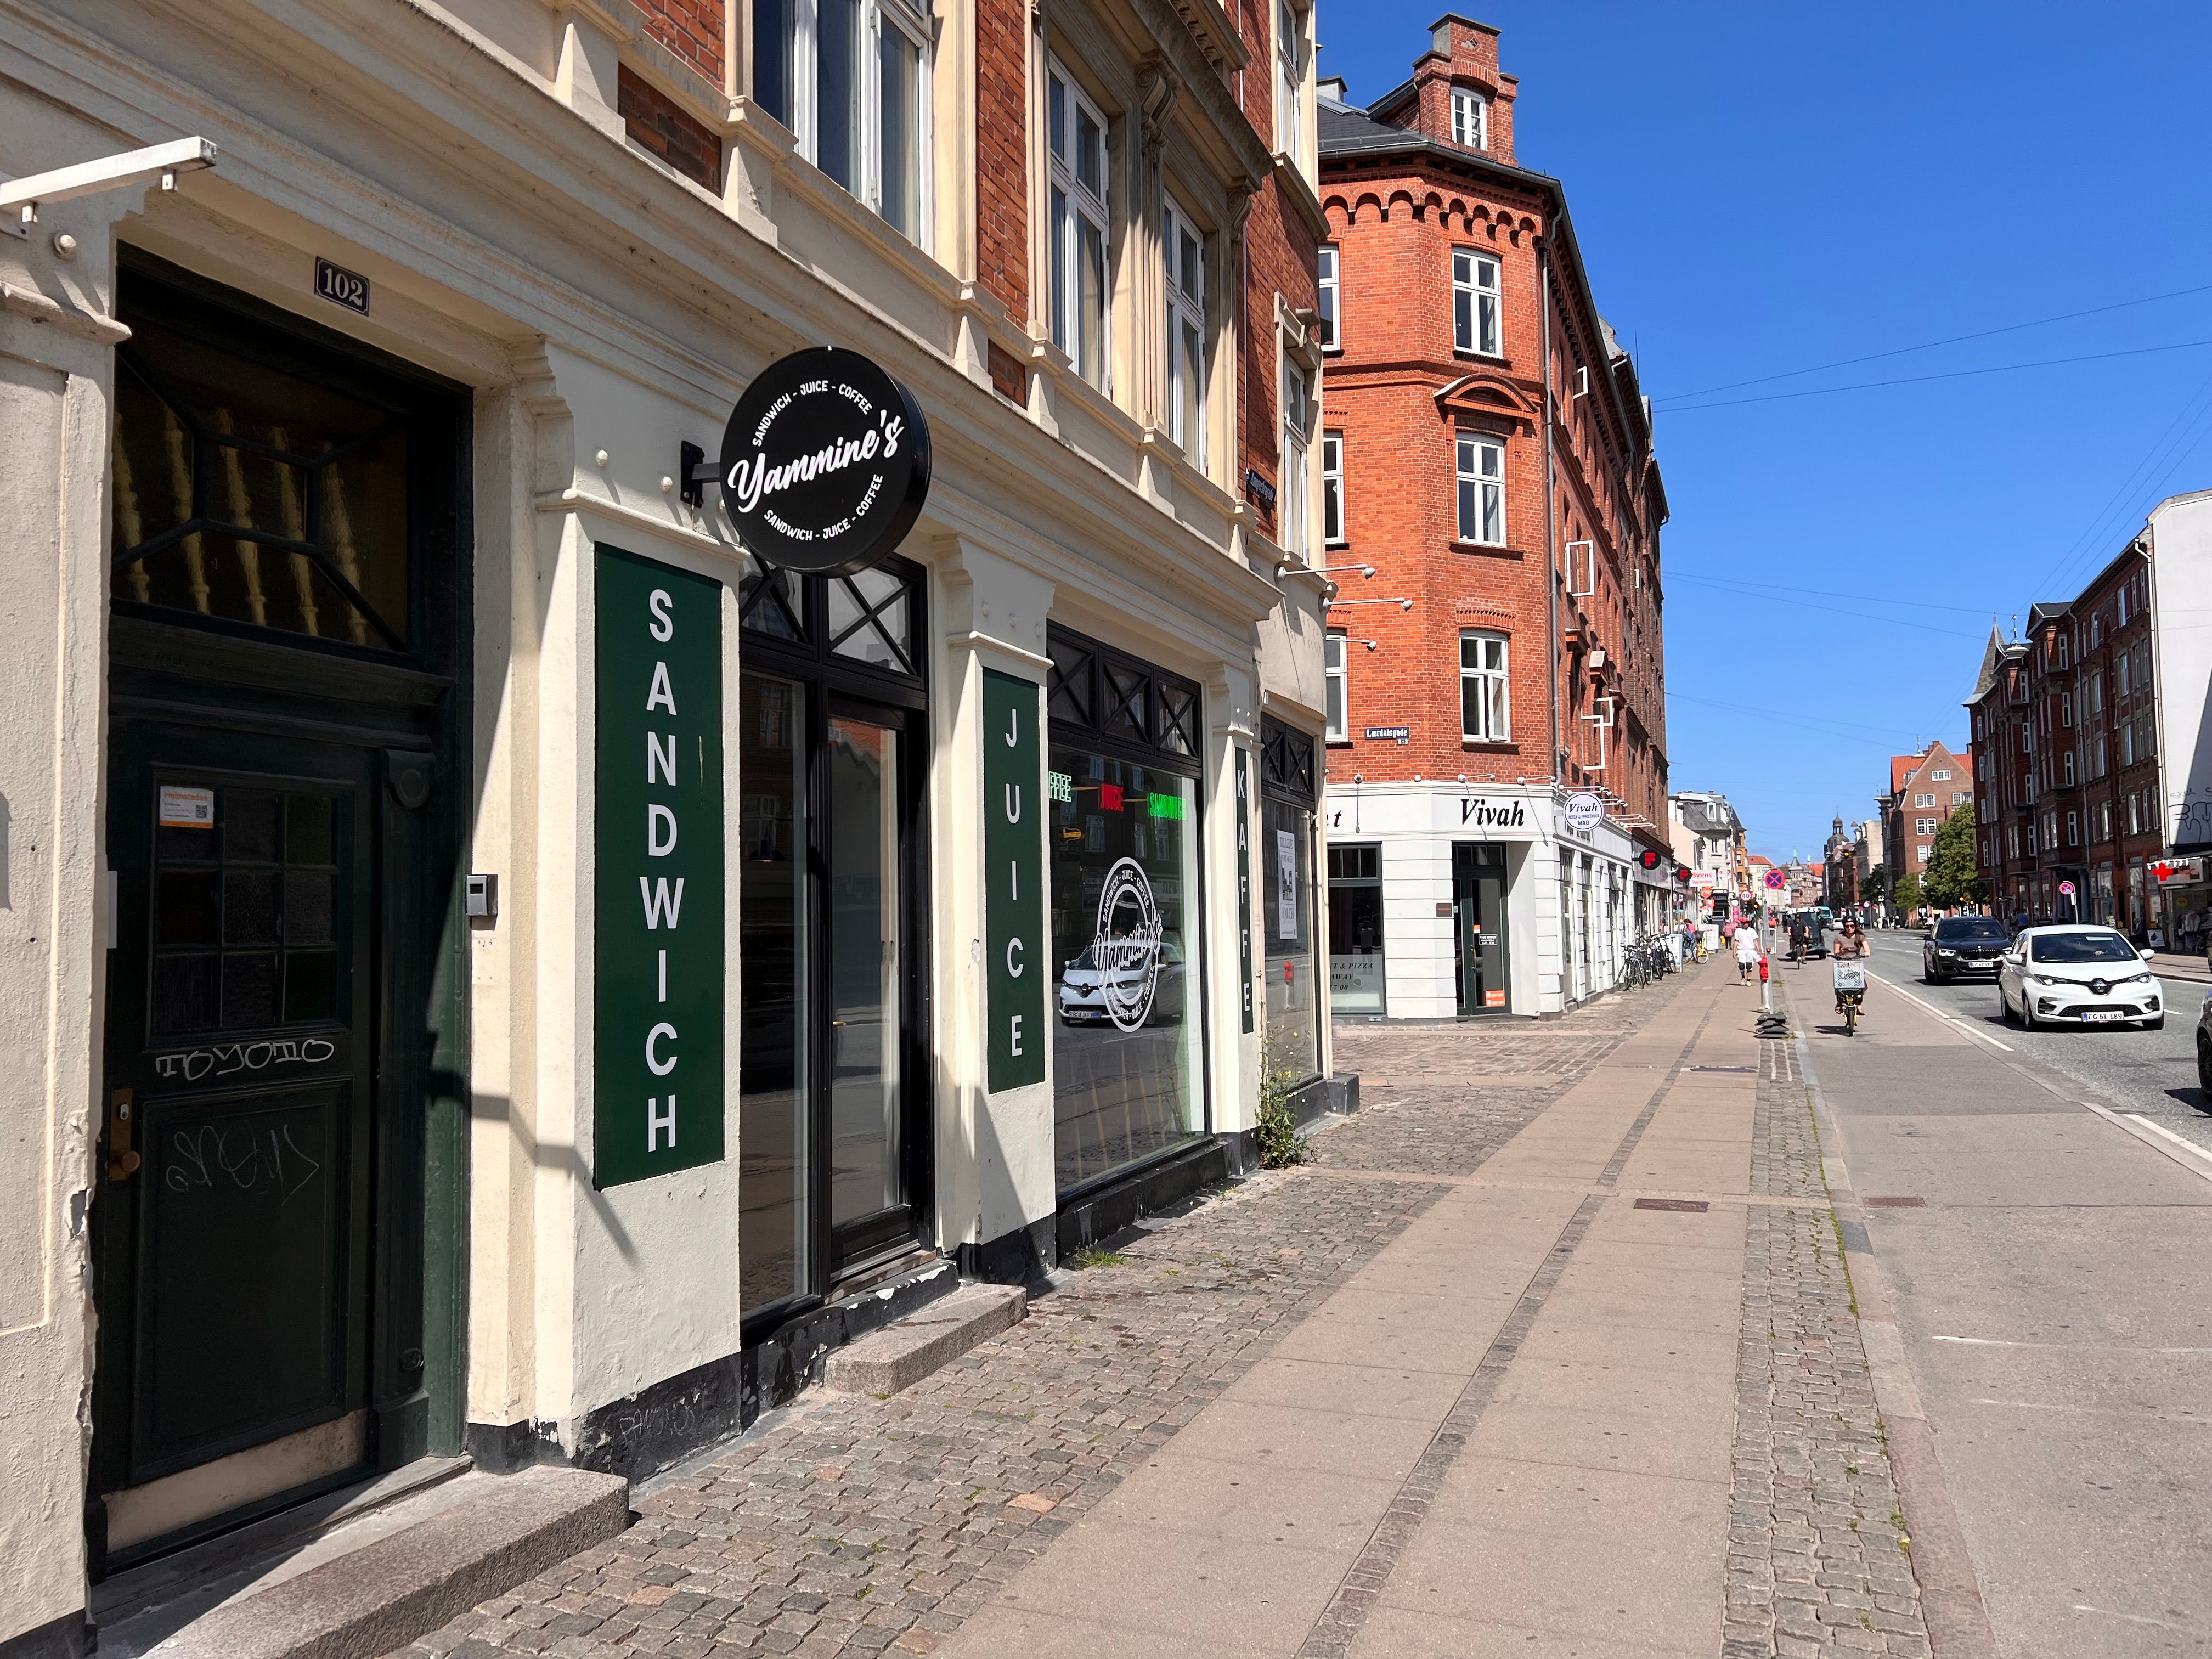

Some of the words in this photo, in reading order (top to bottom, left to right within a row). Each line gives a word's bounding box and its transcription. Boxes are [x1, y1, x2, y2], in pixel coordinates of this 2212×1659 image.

[324, 268, 363, 306] 102
[752, 392, 792, 447] SANDWICH
[799, 380, 828, 396] JUICE
[838, 383, 873, 415] COFFEE
[727, 409, 905, 513] Yammine's
[764, 510, 813, 541] SANDWICH
[822, 518, 851, 539] JUICE
[856, 473, 883, 517] COFFEE
[1367, 728, 1408, 738] Lærdalsgade
[1101, 783, 1124, 812] JUICE
[1149, 792, 1187, 821] SANDWICH
[1460, 798, 1525, 827] Vivah
[1569, 803, 1598, 813] Vivah
[639, 589, 685, 1153] SANDWICH
[1005, 708, 1024, 1057] JUICE
[1103, 875, 1119, 923] SANDWICH
[1121, 869, 1133, 881] JUICE
[1136, 877, 1150, 909] COFFEE
[1237, 769, 1251, 1011] KAFFE
[1093, 907, 1163, 991] Yammine's
[1108, 986, 1129, 1020] SANDWICH
[1131, 1005, 1144, 1020] JUICE
[1144, 964, 1154, 1001] COFFEE
